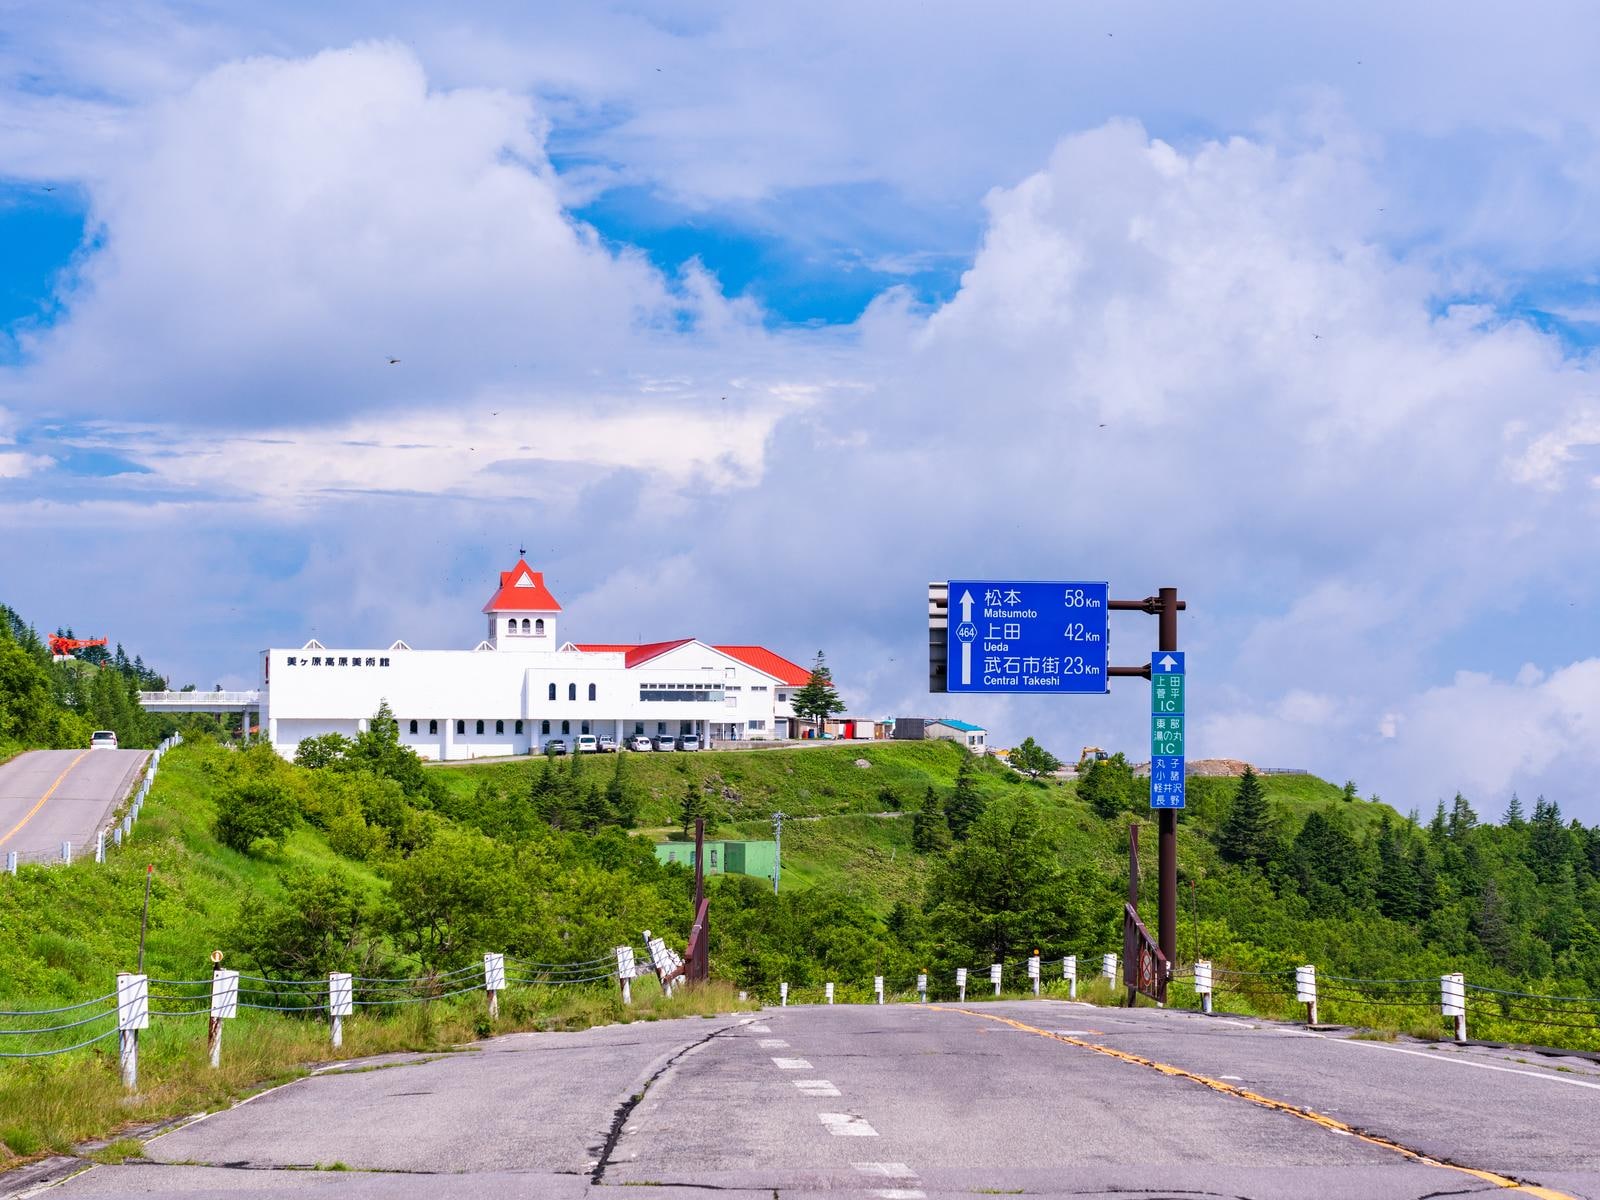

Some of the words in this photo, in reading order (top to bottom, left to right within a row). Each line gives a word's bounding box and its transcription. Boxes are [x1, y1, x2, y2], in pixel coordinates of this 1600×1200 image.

[984, 589, 1022, 607] 松本
[984, 608, 1037, 618] Matsumoto
[959, 627, 975, 637] 464
[984, 623, 1020, 640] 上田
[984, 642, 1009, 652] Ueda
[984, 656, 1060, 674] 武石市街
[984, 675, 1018, 685] Central
[1023, 675, 1060, 685] Takeshi
[1154, 783, 1182, 793] 軽井沢
[1156, 795, 1180, 806] 長野
